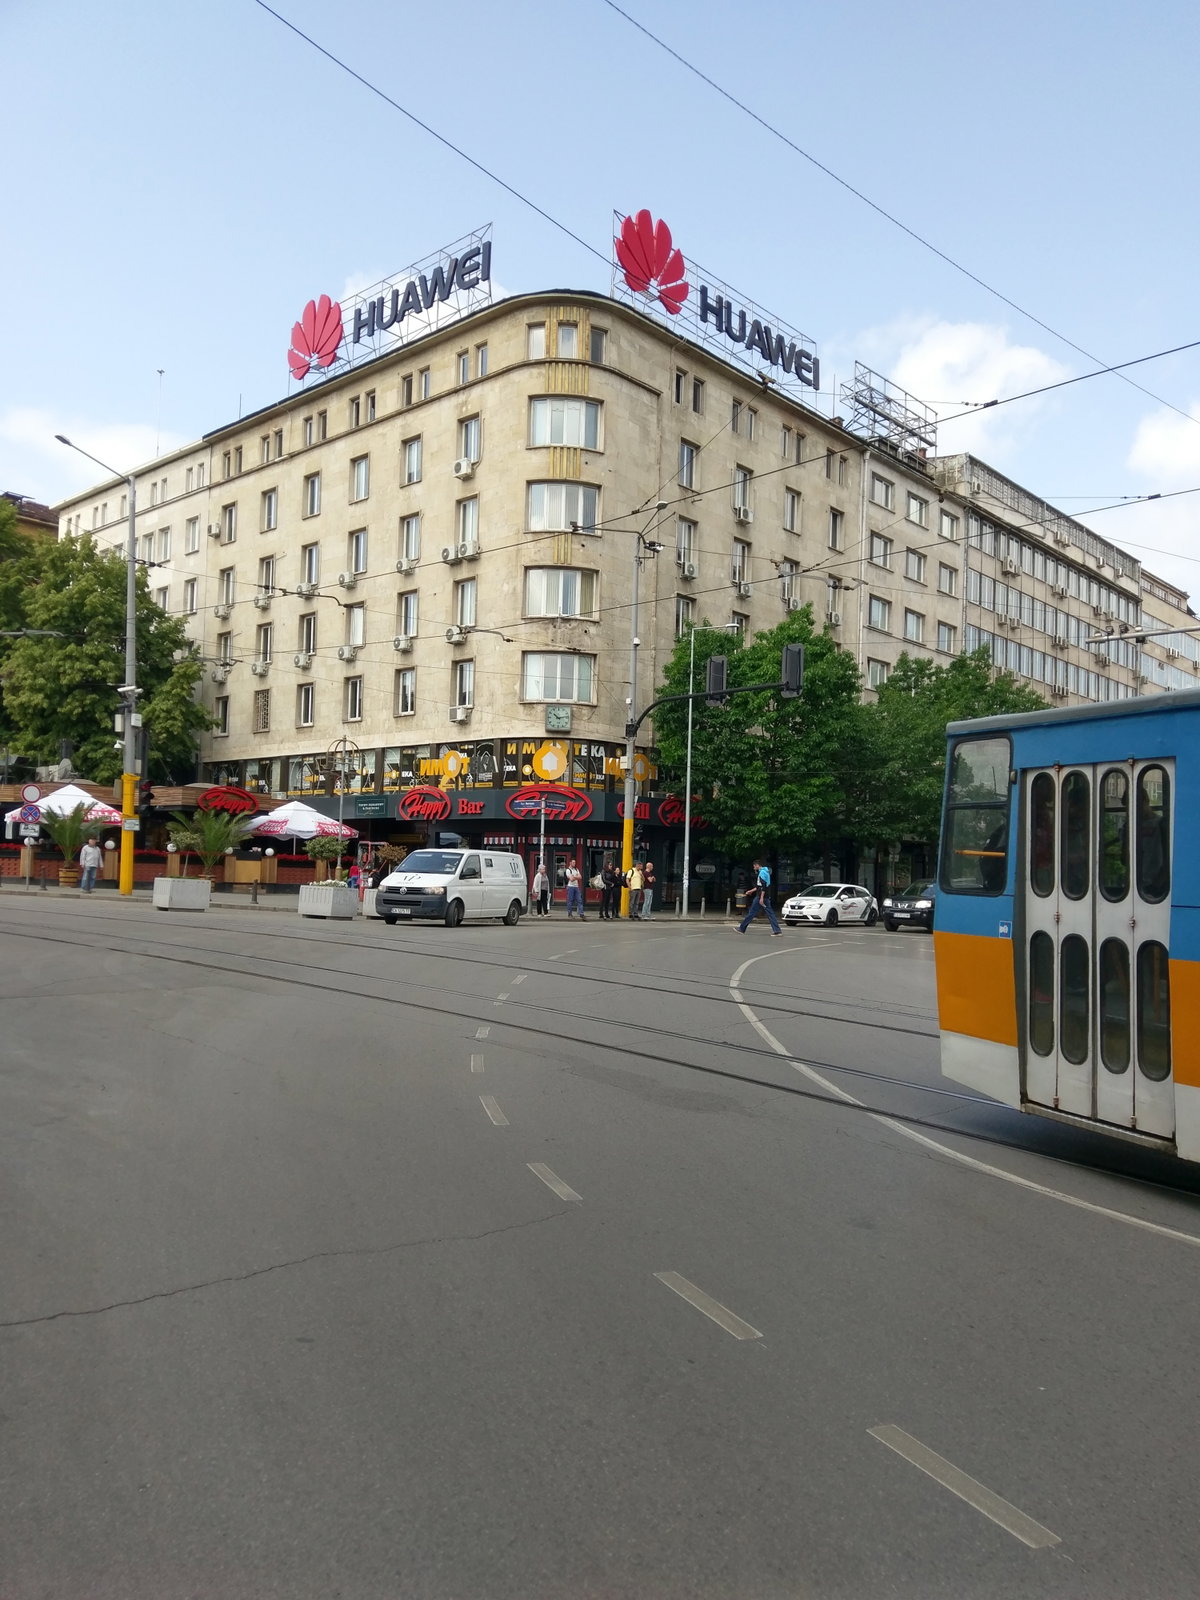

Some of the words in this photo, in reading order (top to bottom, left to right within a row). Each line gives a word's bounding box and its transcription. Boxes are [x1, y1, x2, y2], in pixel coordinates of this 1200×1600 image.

[353, 241, 491, 343] HUAWEI
[700, 285, 820, 391] HUAWEI
[204, 791, 254, 814] Happy
[404, 794, 447, 820] Happy
[458, 799, 485, 814] Bar
